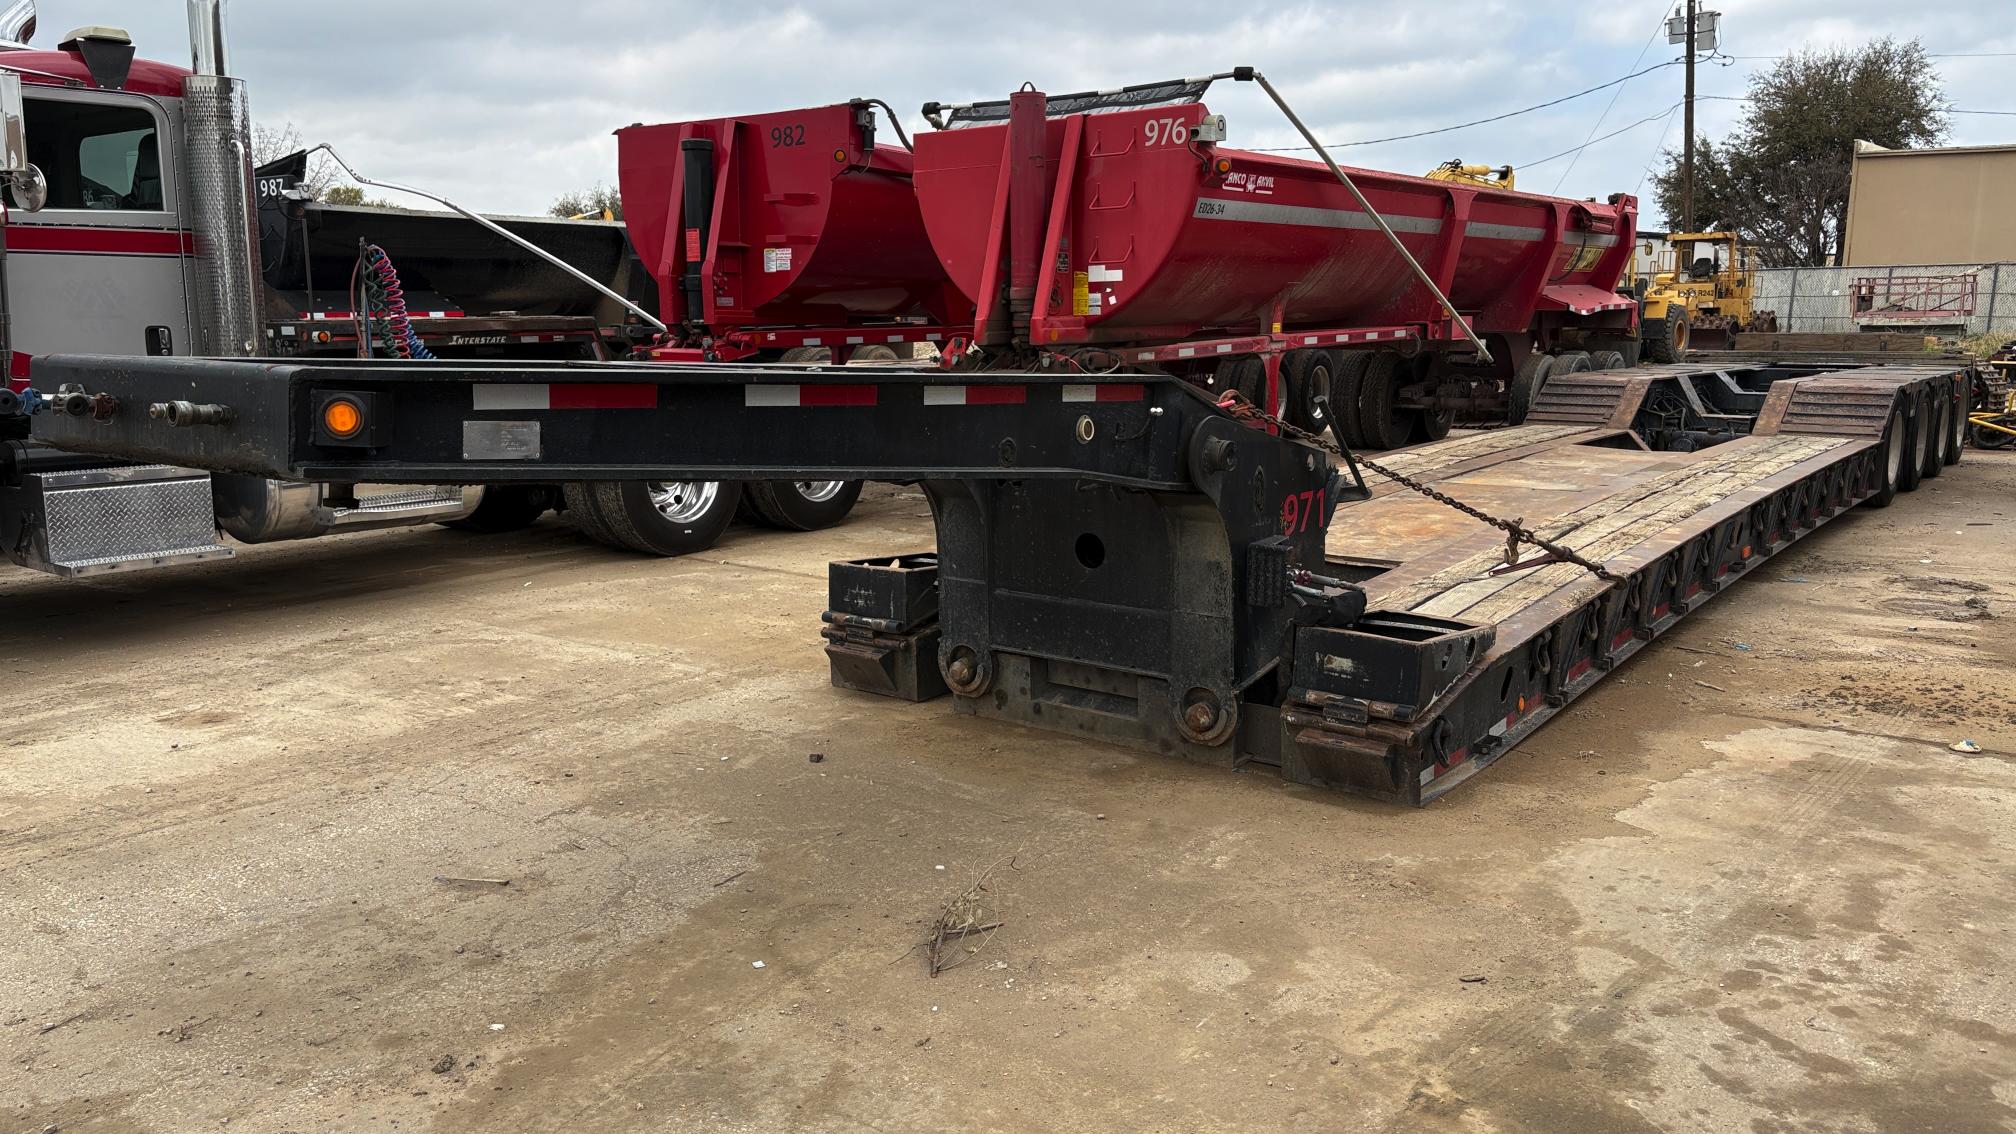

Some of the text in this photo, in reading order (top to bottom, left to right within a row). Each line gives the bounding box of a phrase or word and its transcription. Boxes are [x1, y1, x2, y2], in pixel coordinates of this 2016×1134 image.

[771, 124, 805, 148] 982
[1145, 118, 1186, 146] 976
[260, 178, 283, 197] 987
[1225, 172, 1247, 185] ANCO
[1284, 488, 1325, 536] 971
